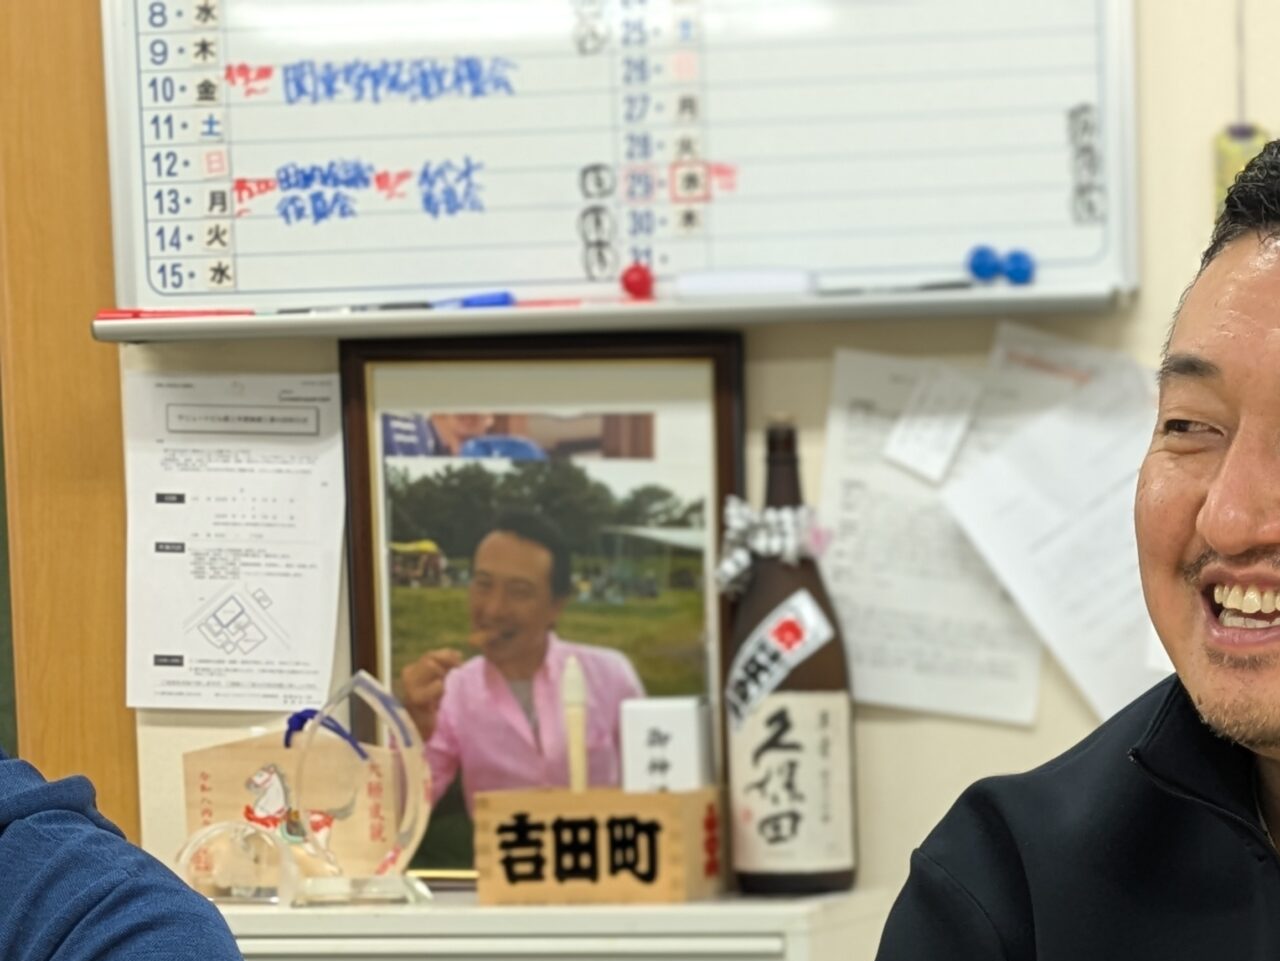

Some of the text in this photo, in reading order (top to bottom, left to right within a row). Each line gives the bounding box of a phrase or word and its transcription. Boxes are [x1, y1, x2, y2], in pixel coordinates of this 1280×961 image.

[194, 0, 217, 24] 水
[193, 38, 216, 62] 木
[195, 78, 218, 102] 金
[200, 113, 222, 137] 土
[205, 150, 226, 174] 日
[208, 190, 228, 213] 月
[206, 224, 228, 248] 火
[209, 260, 232, 285] 水
[496, 812, 662, 886] 吉田町
